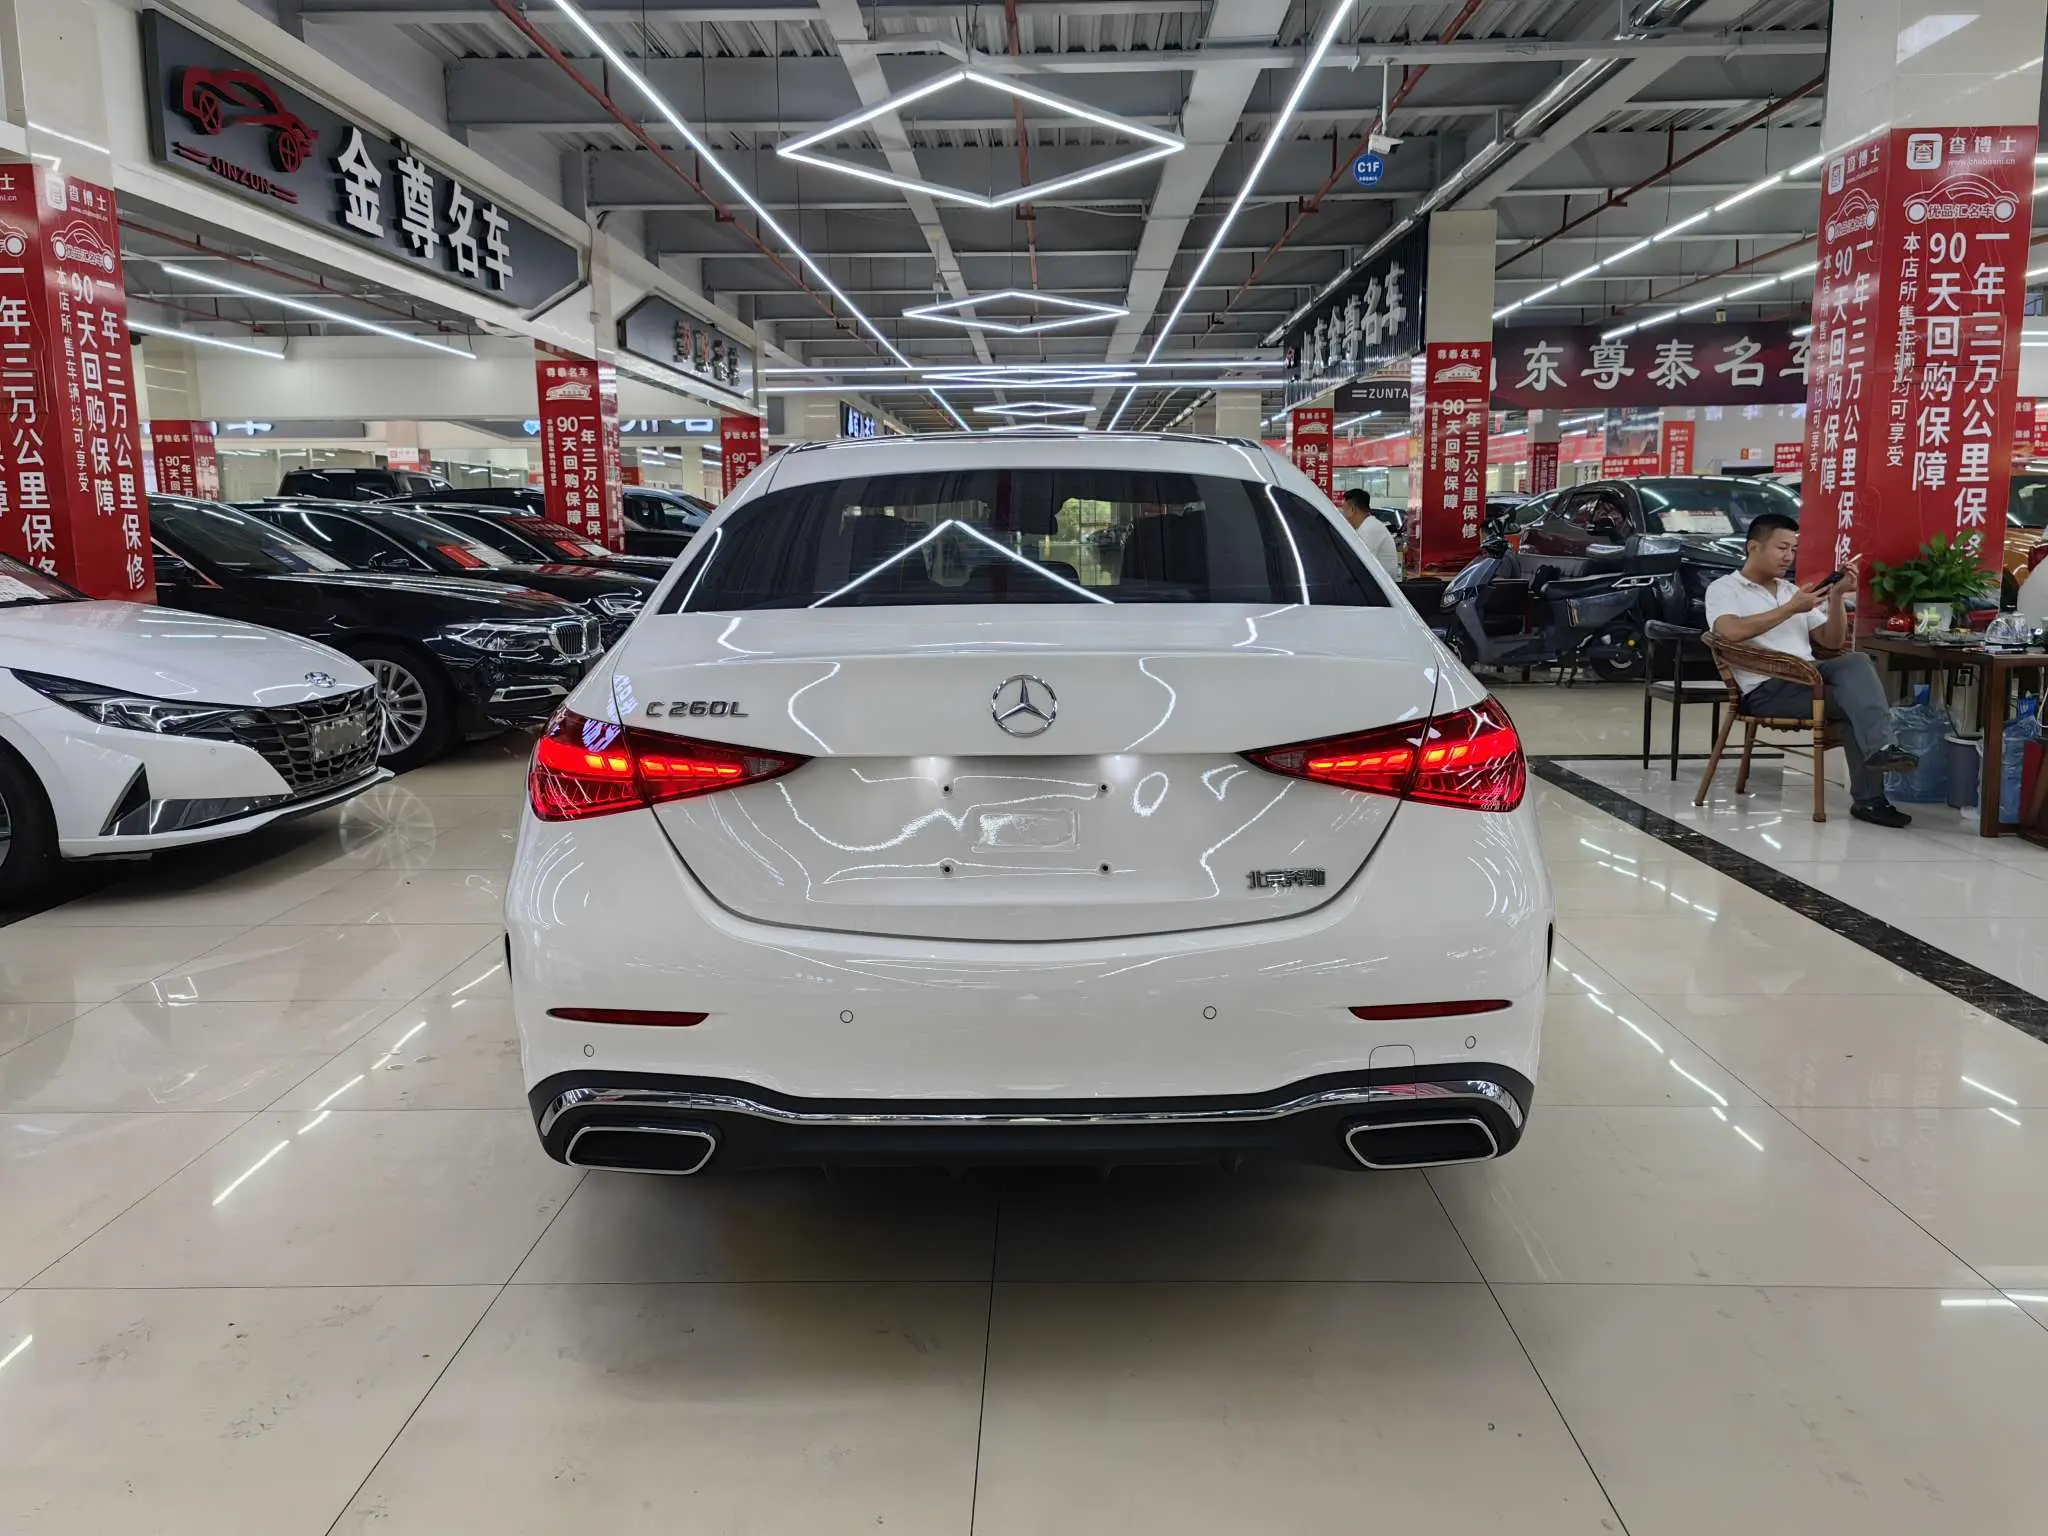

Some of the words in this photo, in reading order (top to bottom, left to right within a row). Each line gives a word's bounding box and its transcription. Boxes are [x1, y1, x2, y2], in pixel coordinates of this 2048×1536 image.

[212, 157, 272, 195] JINZUN
[338, 126, 513, 291] 金尊名车
[1357, 161, 1380, 173] C1F
[1949, 136, 2017, 155] 查博士
[1928, 203, 1995, 220] 优品汇名车
[55, 265, 91, 493] 本店所售车辆均可享受
[71, 272, 116, 517] 90天回购保障
[1490, 335, 1811, 391] 东尊泰名车
[1820, 246, 1853, 495] 90天回购保障
[1886, 231, 1921, 467] 本店所售车辆均可享受
[1911, 232, 1967, 492] 90天回购保障
[96, 279, 146, 590] 一年三万公里保修
[556, 416, 582, 526] 90天回购保障
[579, 415, 602, 546] 一年三万公里保
[732, 452, 747, 485] 90天
[1442, 399, 1465, 510] 90天回购保障
[1461, 398, 1482, 539] 一年三万公里保修
